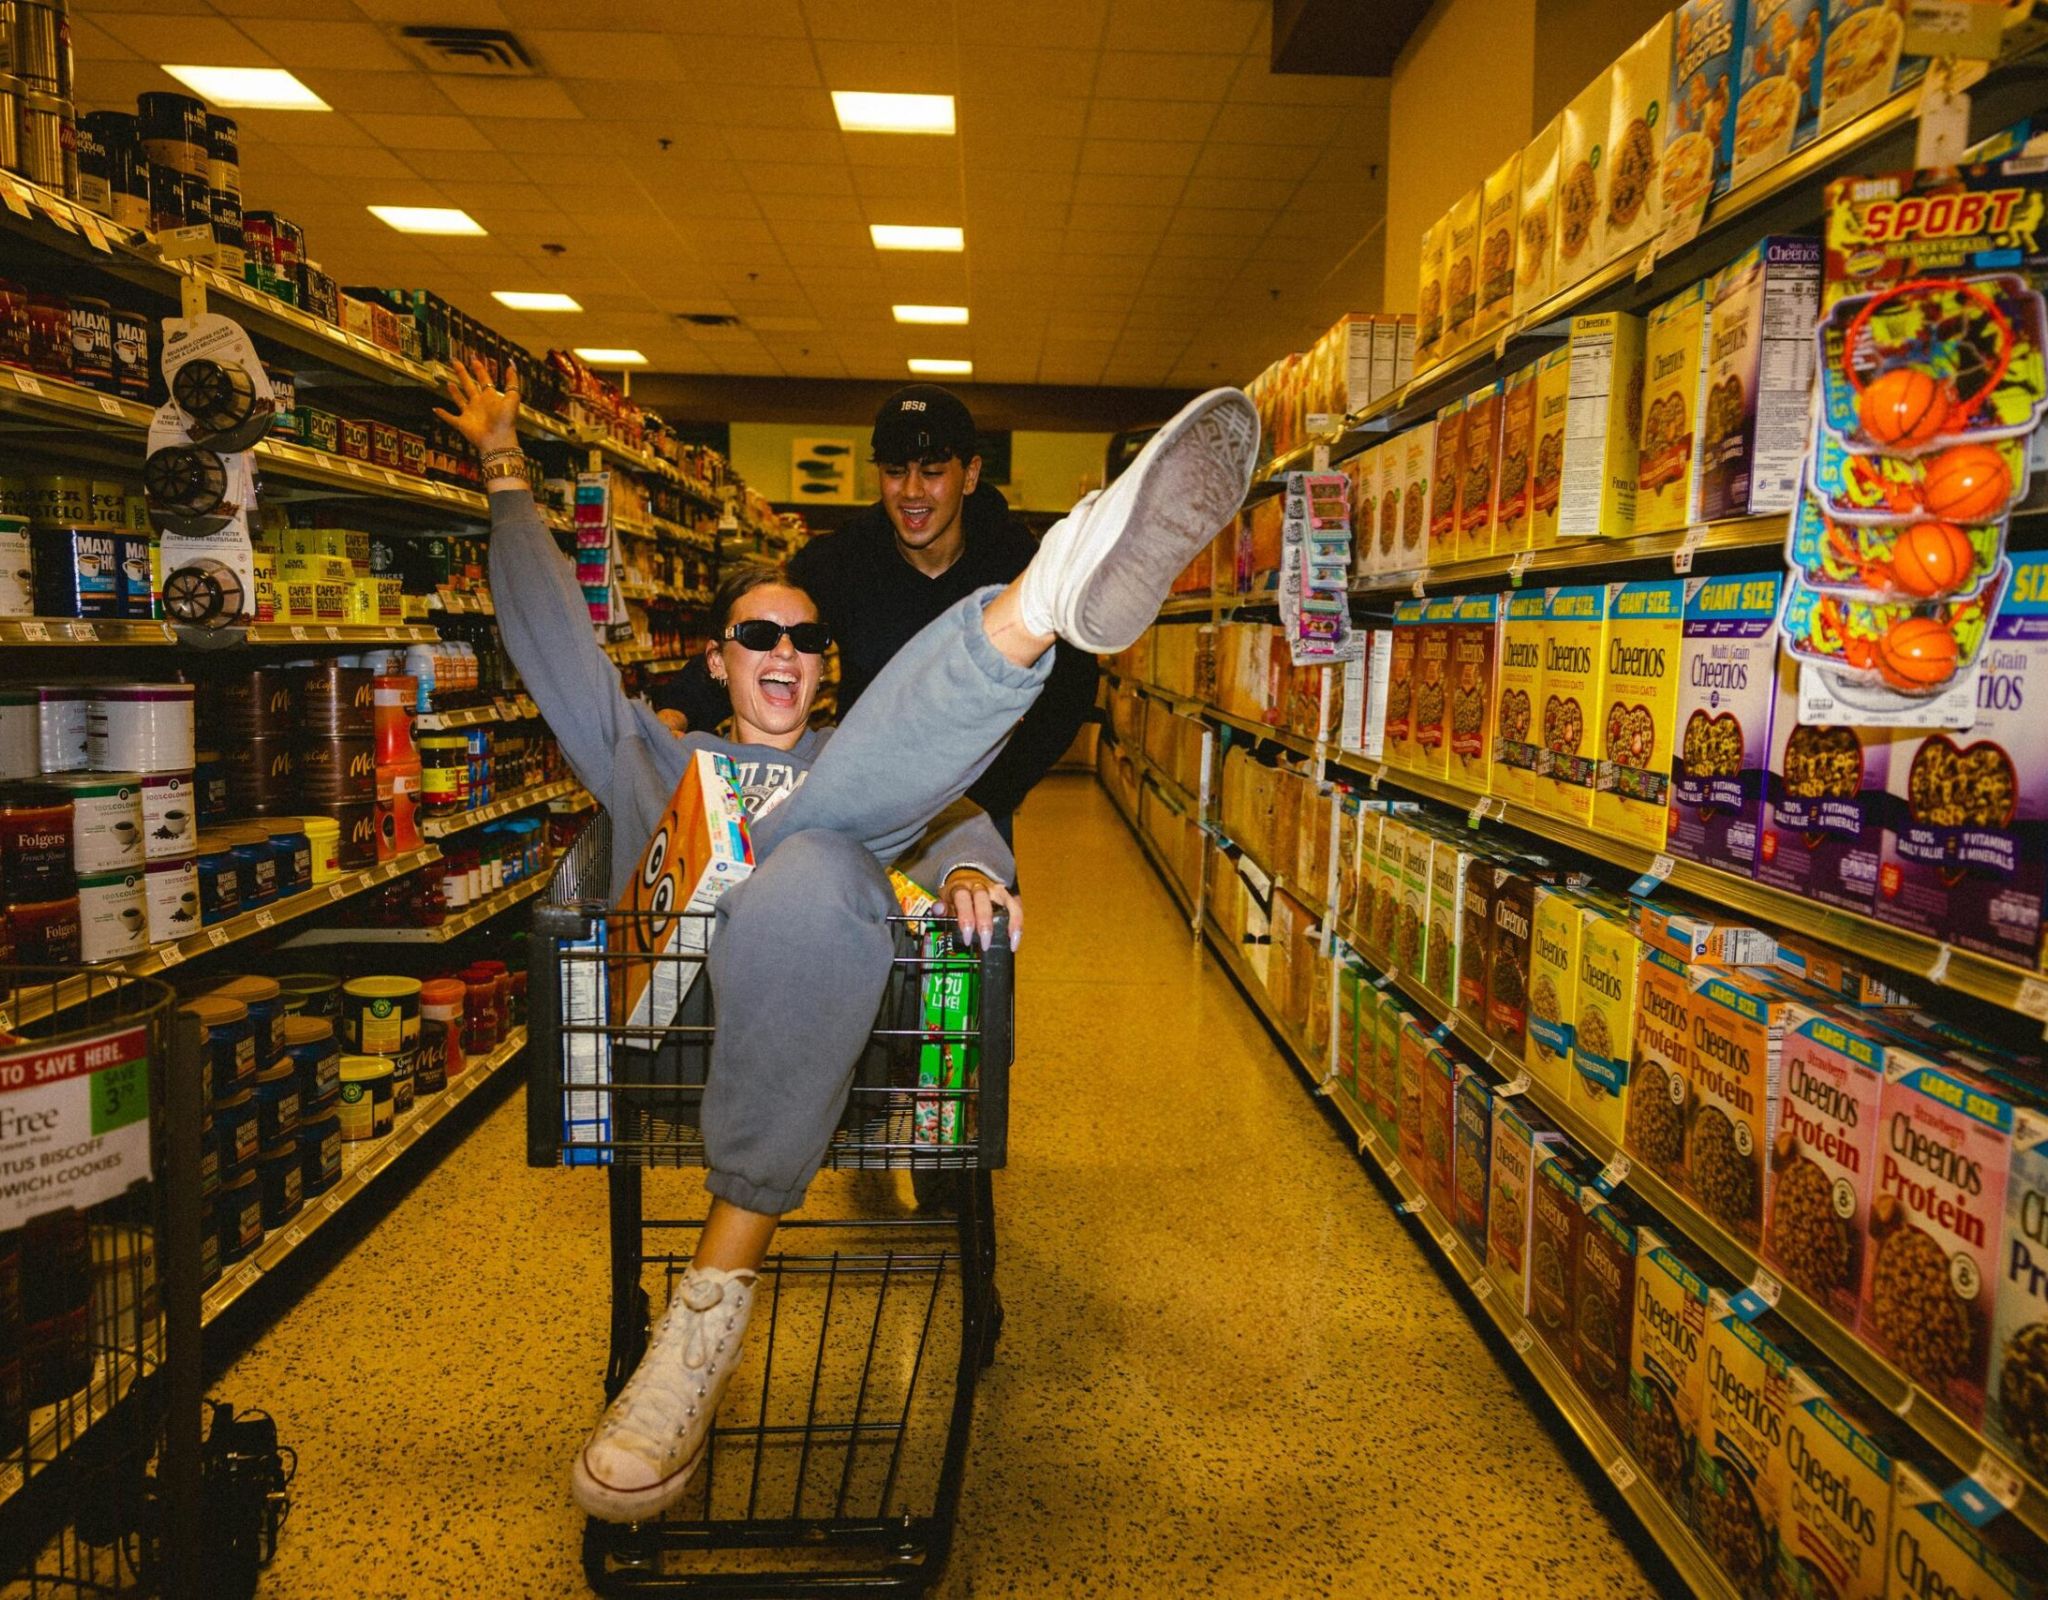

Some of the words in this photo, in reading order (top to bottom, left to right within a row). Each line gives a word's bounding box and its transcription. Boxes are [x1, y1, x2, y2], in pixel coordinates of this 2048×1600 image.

[1864, 188, 2022, 239] SPORT
[1768, 245, 1820, 261] Cheerios
[312, 416, 337, 440] PILON
[344, 424, 368, 448] PILON
[376, 430, 398, 453] PILON
[1552, 597, 1577, 616] GIANT
[1578, 596, 1595, 616] SIZE
[1617, 591, 1646, 614] GIANT
[1647, 591, 1671, 613] SIZE
[1700, 583, 1741, 611] GIANT
[1741, 581, 1776, 610] SIZE
[1503, 636, 1539, 669] Cheerios
[1546, 637, 1591, 673] Cheerios
[1609, 638, 1665, 678] Cheerios
[1711, 644, 1729, 658] Multi
[1731, 646, 1750, 661] Grain
[1691, 653, 1748, 690] Cheerios
[1677, 789, 1691, 802] DAILY
[1691, 791, 1704, 803] VALUE
[1683, 780, 1698, 791] 100%
[1715, 794, 1742, 808] MINERALS
[1716, 781, 1742, 795] VITAMINS
[1775, 809, 1794, 826] DAILY
[1793, 814, 1809, 826] VALUE
[1783, 801, 1802, 814] 100%
[1827, 803, 1860, 818] VITAMINS
[18, 832, 65, 849] Folgers
[1825, 816, 1861, 834] MINERALS
[1910, 829, 1935, 844] 100%
[1899, 837, 1923, 857] DAILY
[1922, 844, 1944, 860] VALUE
[1967, 846, 2015, 871] MINERALS
[1969, 833, 2013, 854] VITAMINS
[1496, 899, 1529, 940] Cheerios
[1535, 926, 1568, 971] Cheerios
[934, 976, 962, 995] YOU
[1581, 954, 1622, 1002] Cheerios
[932, 994, 960, 1010] LIKE!
[1642, 980, 1688, 1031] Cheerios
[1709, 983, 1736, 1006] LARGE
[1737, 994, 1757, 1017] SIZE
[1638, 1013, 1686, 1067] Protein
[1694, 1015, 1751, 1076] Cheerios
[1811, 1020, 1846, 1051] LARGE
[1846, 1038, 1873, 1065] SIZE
[0, 1064, 25, 1086] TO
[35, 1056, 77, 1081] SAVE
[84, 1043, 124, 1069] HERE.
[103, 1067, 136, 1086] SAVE
[1806, 1049, 1848, 1086] Strawberry
[1691, 1050, 1754, 1115] Protein
[1787, 1057, 1859, 1129] Cheerios
[1919, 1070, 1964, 1111] LARGE
[1965, 1092, 1999, 1125] SIZE
[0, 1104, 59, 1140] Free
[1781, 1096, 1860, 1174] Protein
[1914, 1103, 1966, 1148] Strawberry
[40, 1137, 104, 1168] BISCOFF
[57, 1152, 123, 1185] COOKIES
[1890, 1110, 1983, 1198] Cheerios
[1881, 1153, 1986, 1249] Protein
[1585, 1231, 1621, 1290] Cheerios
[1638, 1276, 1698, 1363] Cheerios
[1707, 1344, 1782, 1447] Cheerios
[1787, 1426, 1876, 1546] Cheerios
